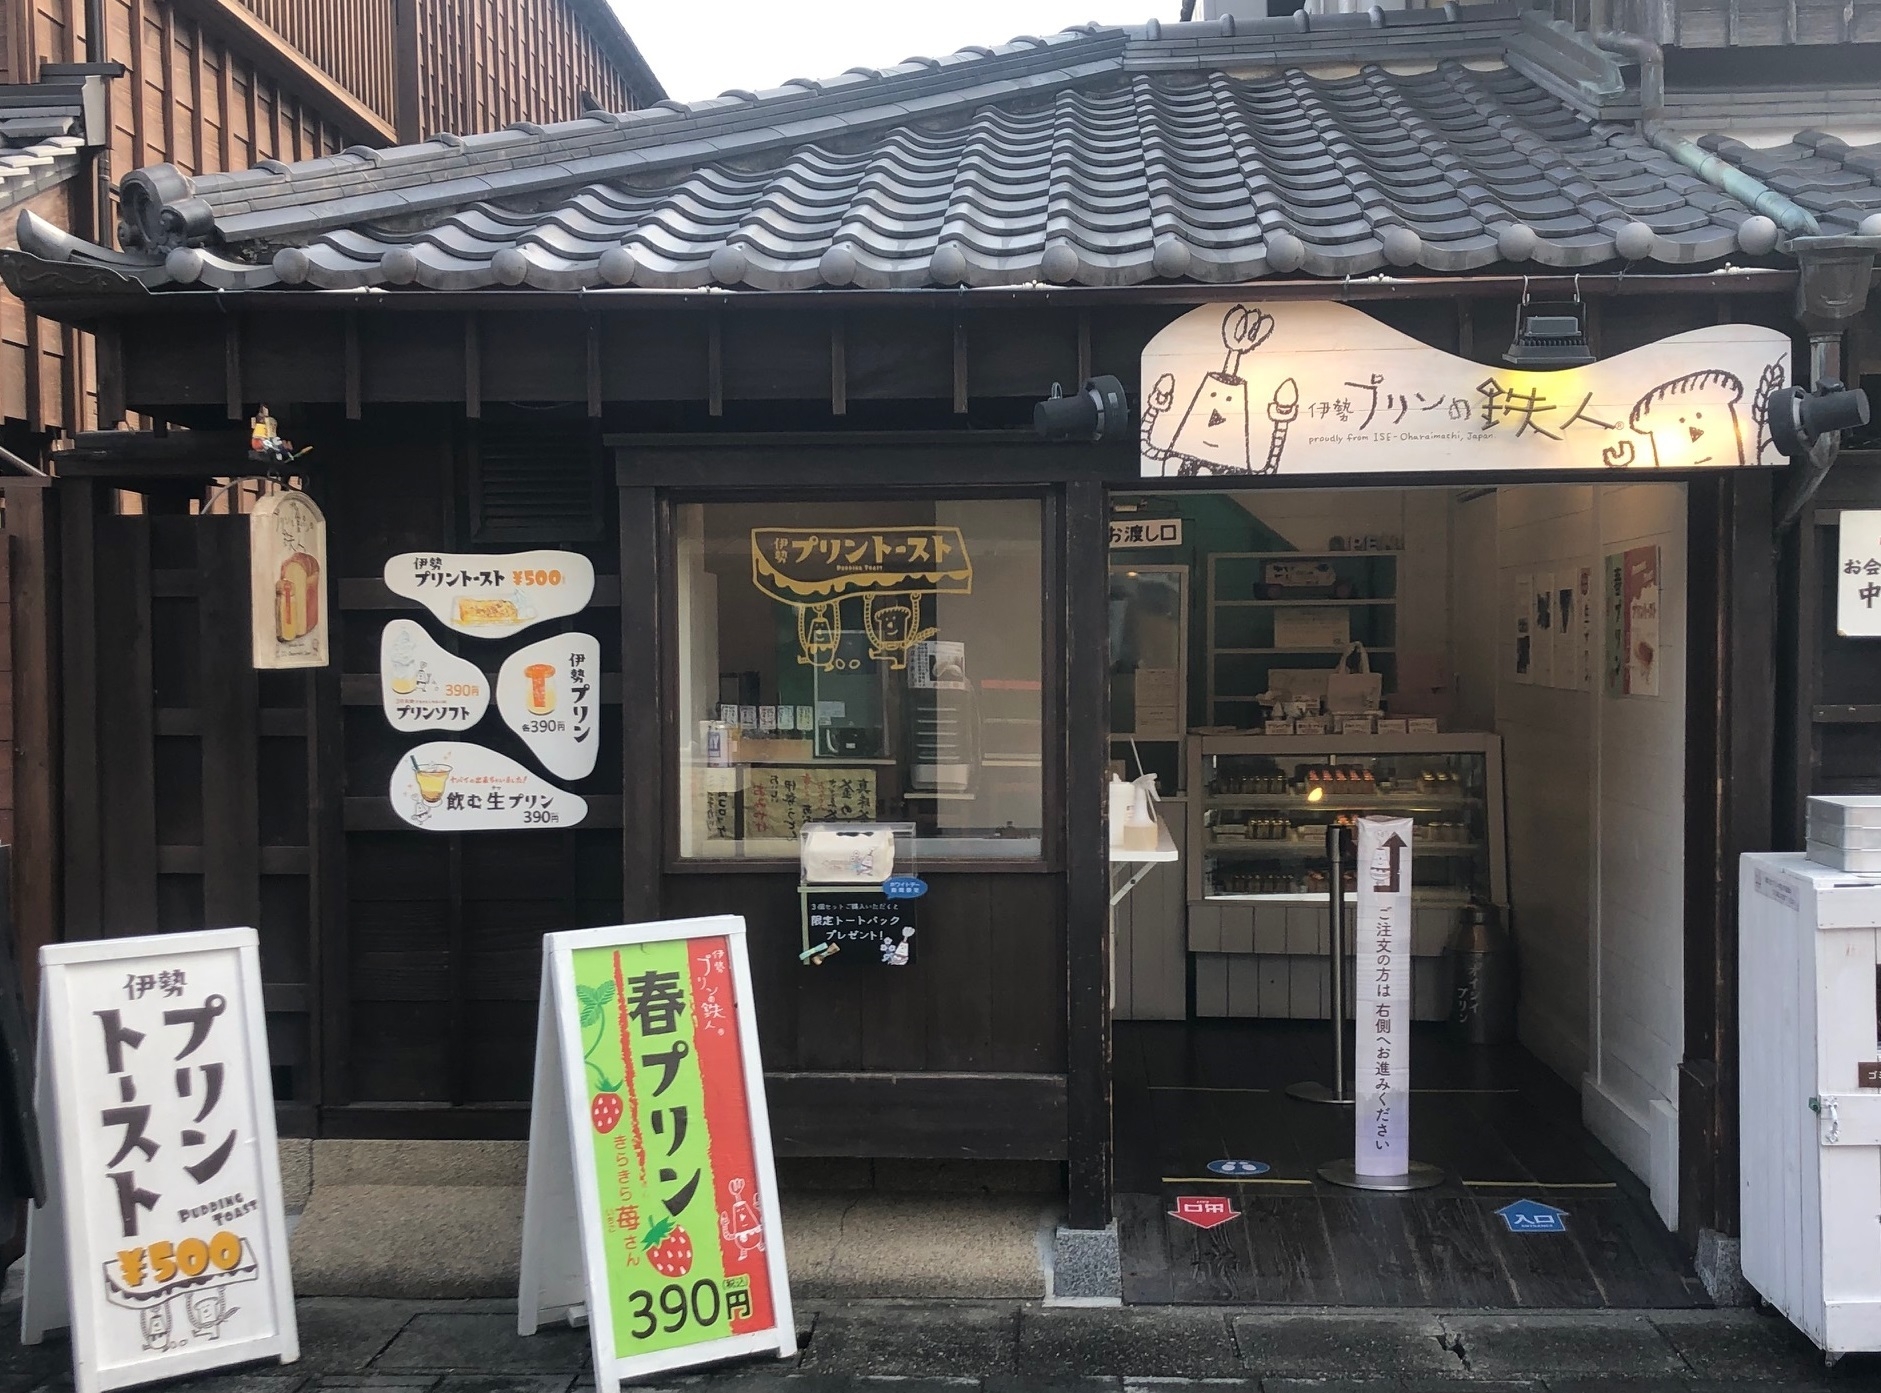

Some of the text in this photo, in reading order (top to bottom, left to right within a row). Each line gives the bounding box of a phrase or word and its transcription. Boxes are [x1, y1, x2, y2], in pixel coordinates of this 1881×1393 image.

[1308, 432, 1344, 445] proudly
[1347, 432, 1369, 442] from
[1110, 525, 1176, 542] お渡し口
[774, 537, 788, 564] 伊勢
[791, 535, 952, 564] プリントースト
[413, 557, 442, 570] 伊勢
[415, 570, 505, 588] プリントースト
[512, 569, 562, 586] ¥500
[445, 684, 479, 697] 390円
[569, 653, 591, 743] 伊勢プリン
[397, 705, 470, 720] プリンソフト
[522, 720, 565, 733] 各390円
[523, 810, 559, 824] 390円
[123, 970, 188, 1000] 伊勢
[162, 993, 240, 1185] プリン
[627, 970, 701, 1217] 春プリン
[93, 1008, 162, 1237] トースト
[178, 1192, 244, 1223] PUDDING
[212, 1199, 258, 1226] TOAST
[1184, 1203, 1224, 1214] 出口
[1514, 1214, 1555, 1224] 入口
[117, 1230, 244, 1288] ¥500
[629, 1277, 751, 1340] 390円
